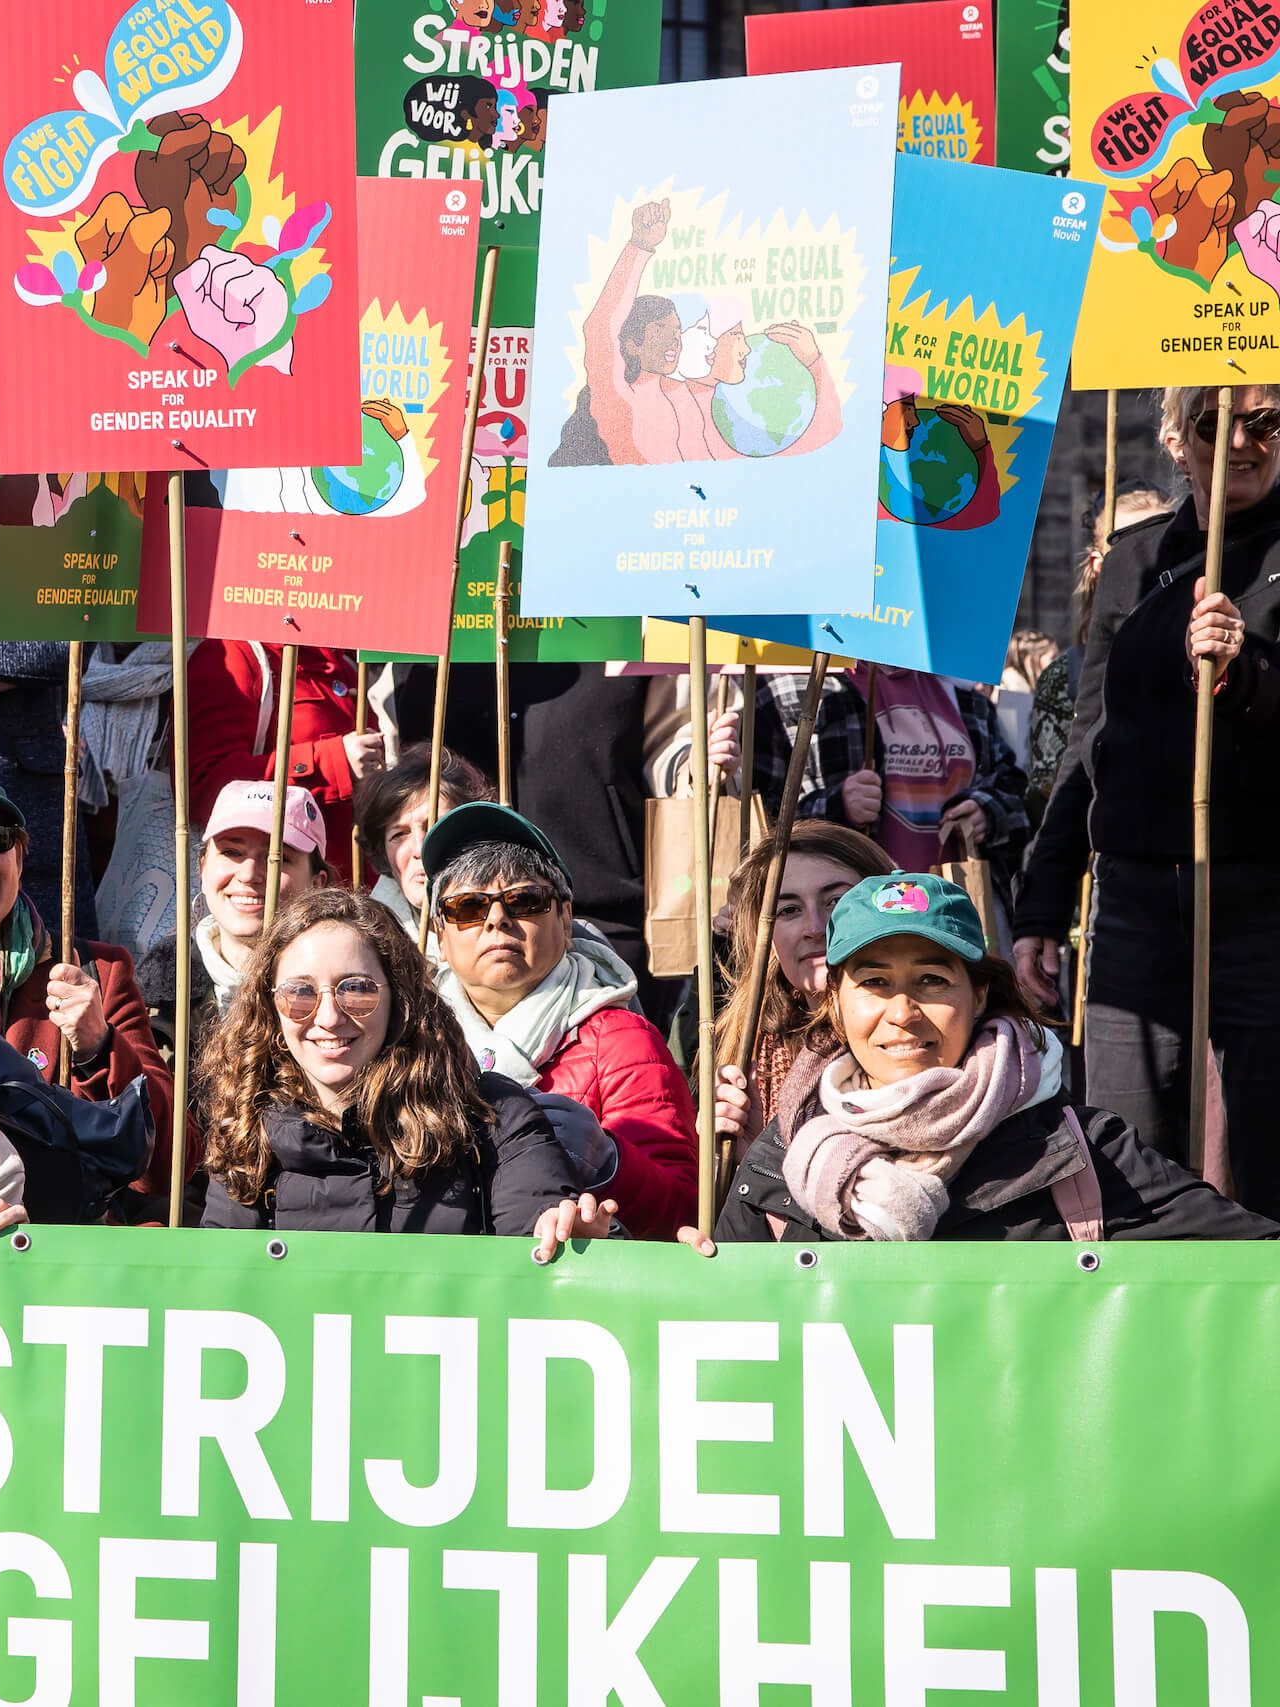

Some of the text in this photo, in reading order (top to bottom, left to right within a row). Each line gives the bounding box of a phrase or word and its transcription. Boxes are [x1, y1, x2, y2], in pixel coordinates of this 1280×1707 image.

[128, 6, 155, 30] FOR
[1200, 5, 1222, 24] FOR
[113, 0, 213, 76] EQUAL
[1186, 0, 1272, 62] EQUAL
[1190, 15, 1280, 86] WORLD
[117, 19, 223, 106] WORLD
[411, 100, 462, 136] VOOR
[1107, 104, 1136, 126] WE
[913, 113, 965, 139] EQUAL
[22, 123, 58, 152] WE
[903, 138, 968, 159] WORLD
[440, 215, 469, 224] OXFAM
[1052, 216, 1087, 231] OXFAM
[441, 226, 465, 235] Novib
[672, 225, 705, 249] WE
[1053, 230, 1081, 242] Novib
[652, 244, 844, 289] WORK FOR AN EQUAL
[751, 284, 844, 323] WORLD
[1193, 302, 1270, 318] SPEAK UP
[1222, 322, 1241, 331] FOR
[362, 332, 430, 367] EQUAL
[914, 334, 937, 348] FOR
[1161, 335, 1280, 352] GENDER EQUAL
[914, 348, 932, 360] AN
[945, 331, 1023, 377] EQUAL
[128, 369, 217, 389] SPEAK UP
[927, 366, 1020, 411] WORLD
[161, 394, 184, 406] FOR
[90, 409, 257, 431] GENDER EQUALITY
[653, 507, 738, 528] SPEAK UP
[683, 533, 705, 545] FOR
[63, 553, 118, 570] SPEAK UP
[257, 552, 333, 573] SPEAK UP
[616, 549, 774, 572] GENDER EQUALITY
[82, 574, 96, 584] FOR
[284, 576, 303, 586] FOR
[467, 582, 513, 597] SPEK
[36, 588, 138, 606] GENDER EQUALITY
[223, 587, 363, 612] GENDER EQUALITY
